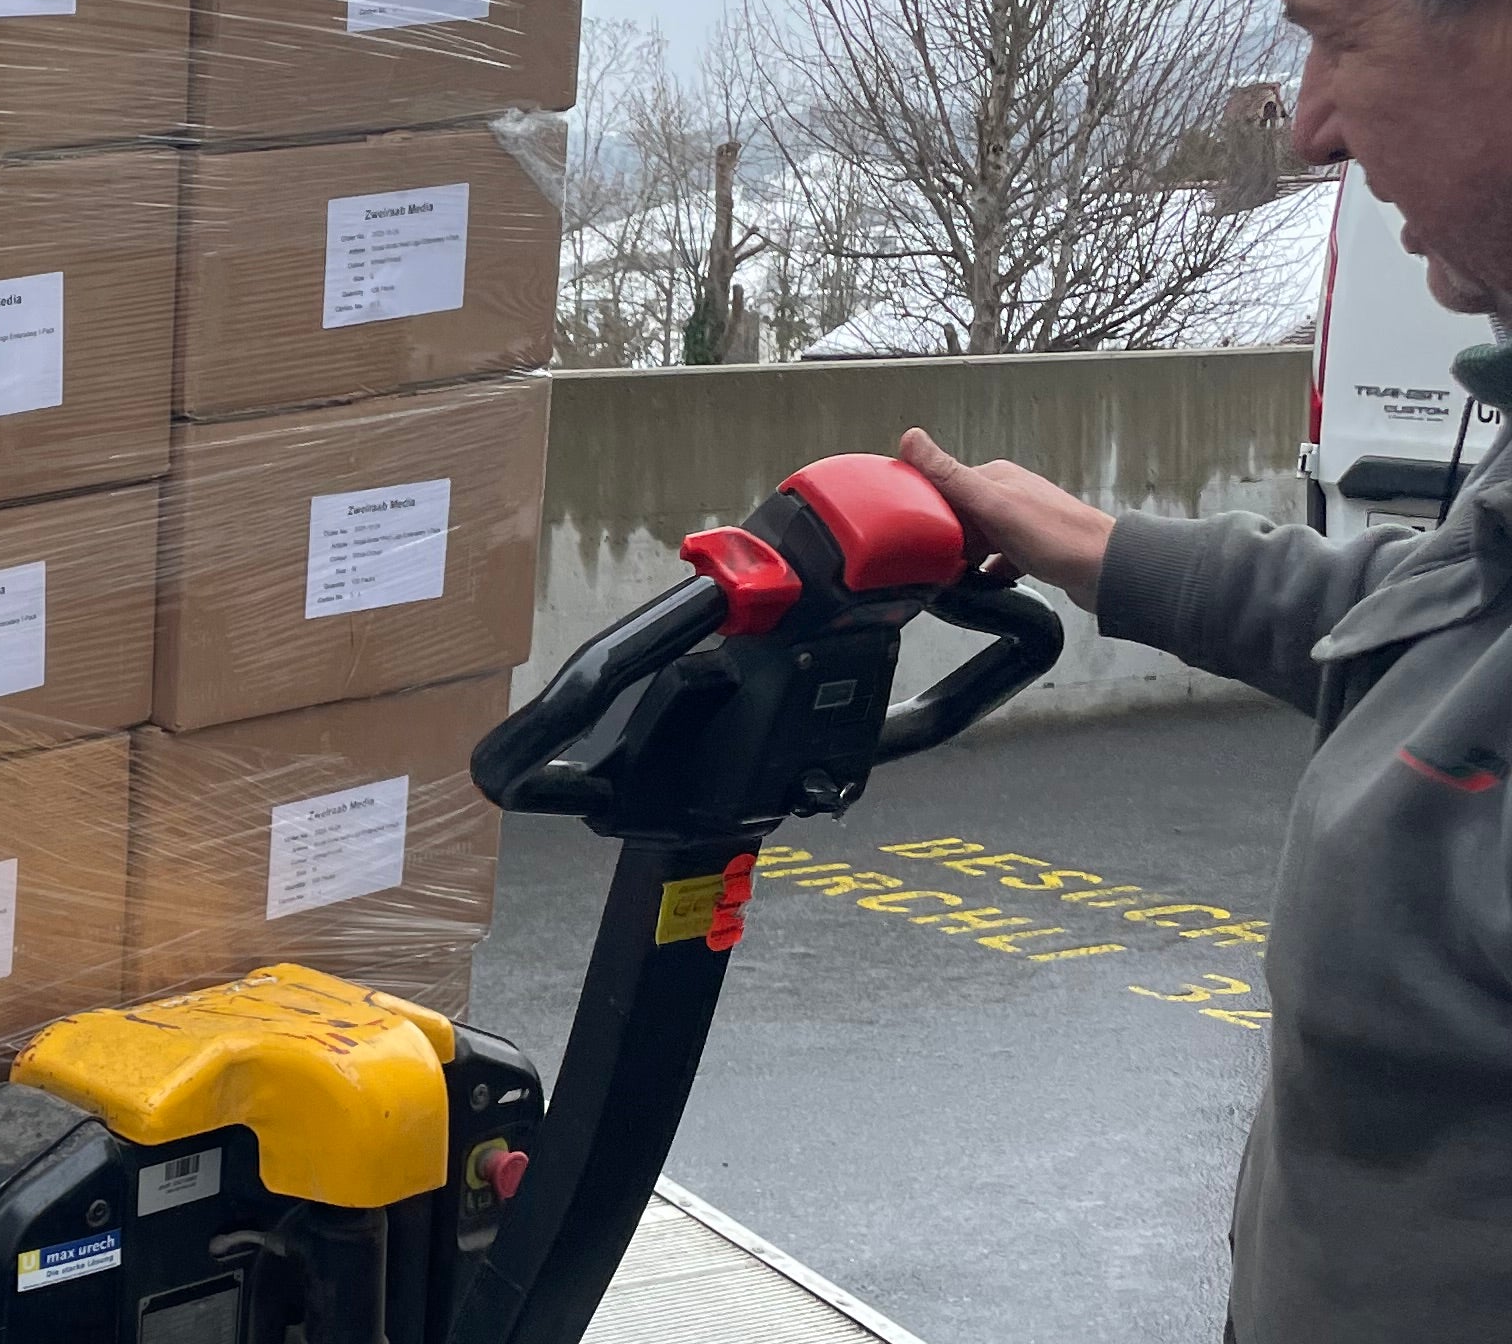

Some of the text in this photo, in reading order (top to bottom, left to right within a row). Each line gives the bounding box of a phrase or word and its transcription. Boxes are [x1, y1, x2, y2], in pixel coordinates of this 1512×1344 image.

[1354, 385, 1451, 401] TRANSIT
[1384, 405, 1450, 416] CUSTOM
[755, 845, 1127, 962] BIRCHLI
[880, 837, 1271, 957] BESUCH
[46, 1235, 115, 1264] max urech
